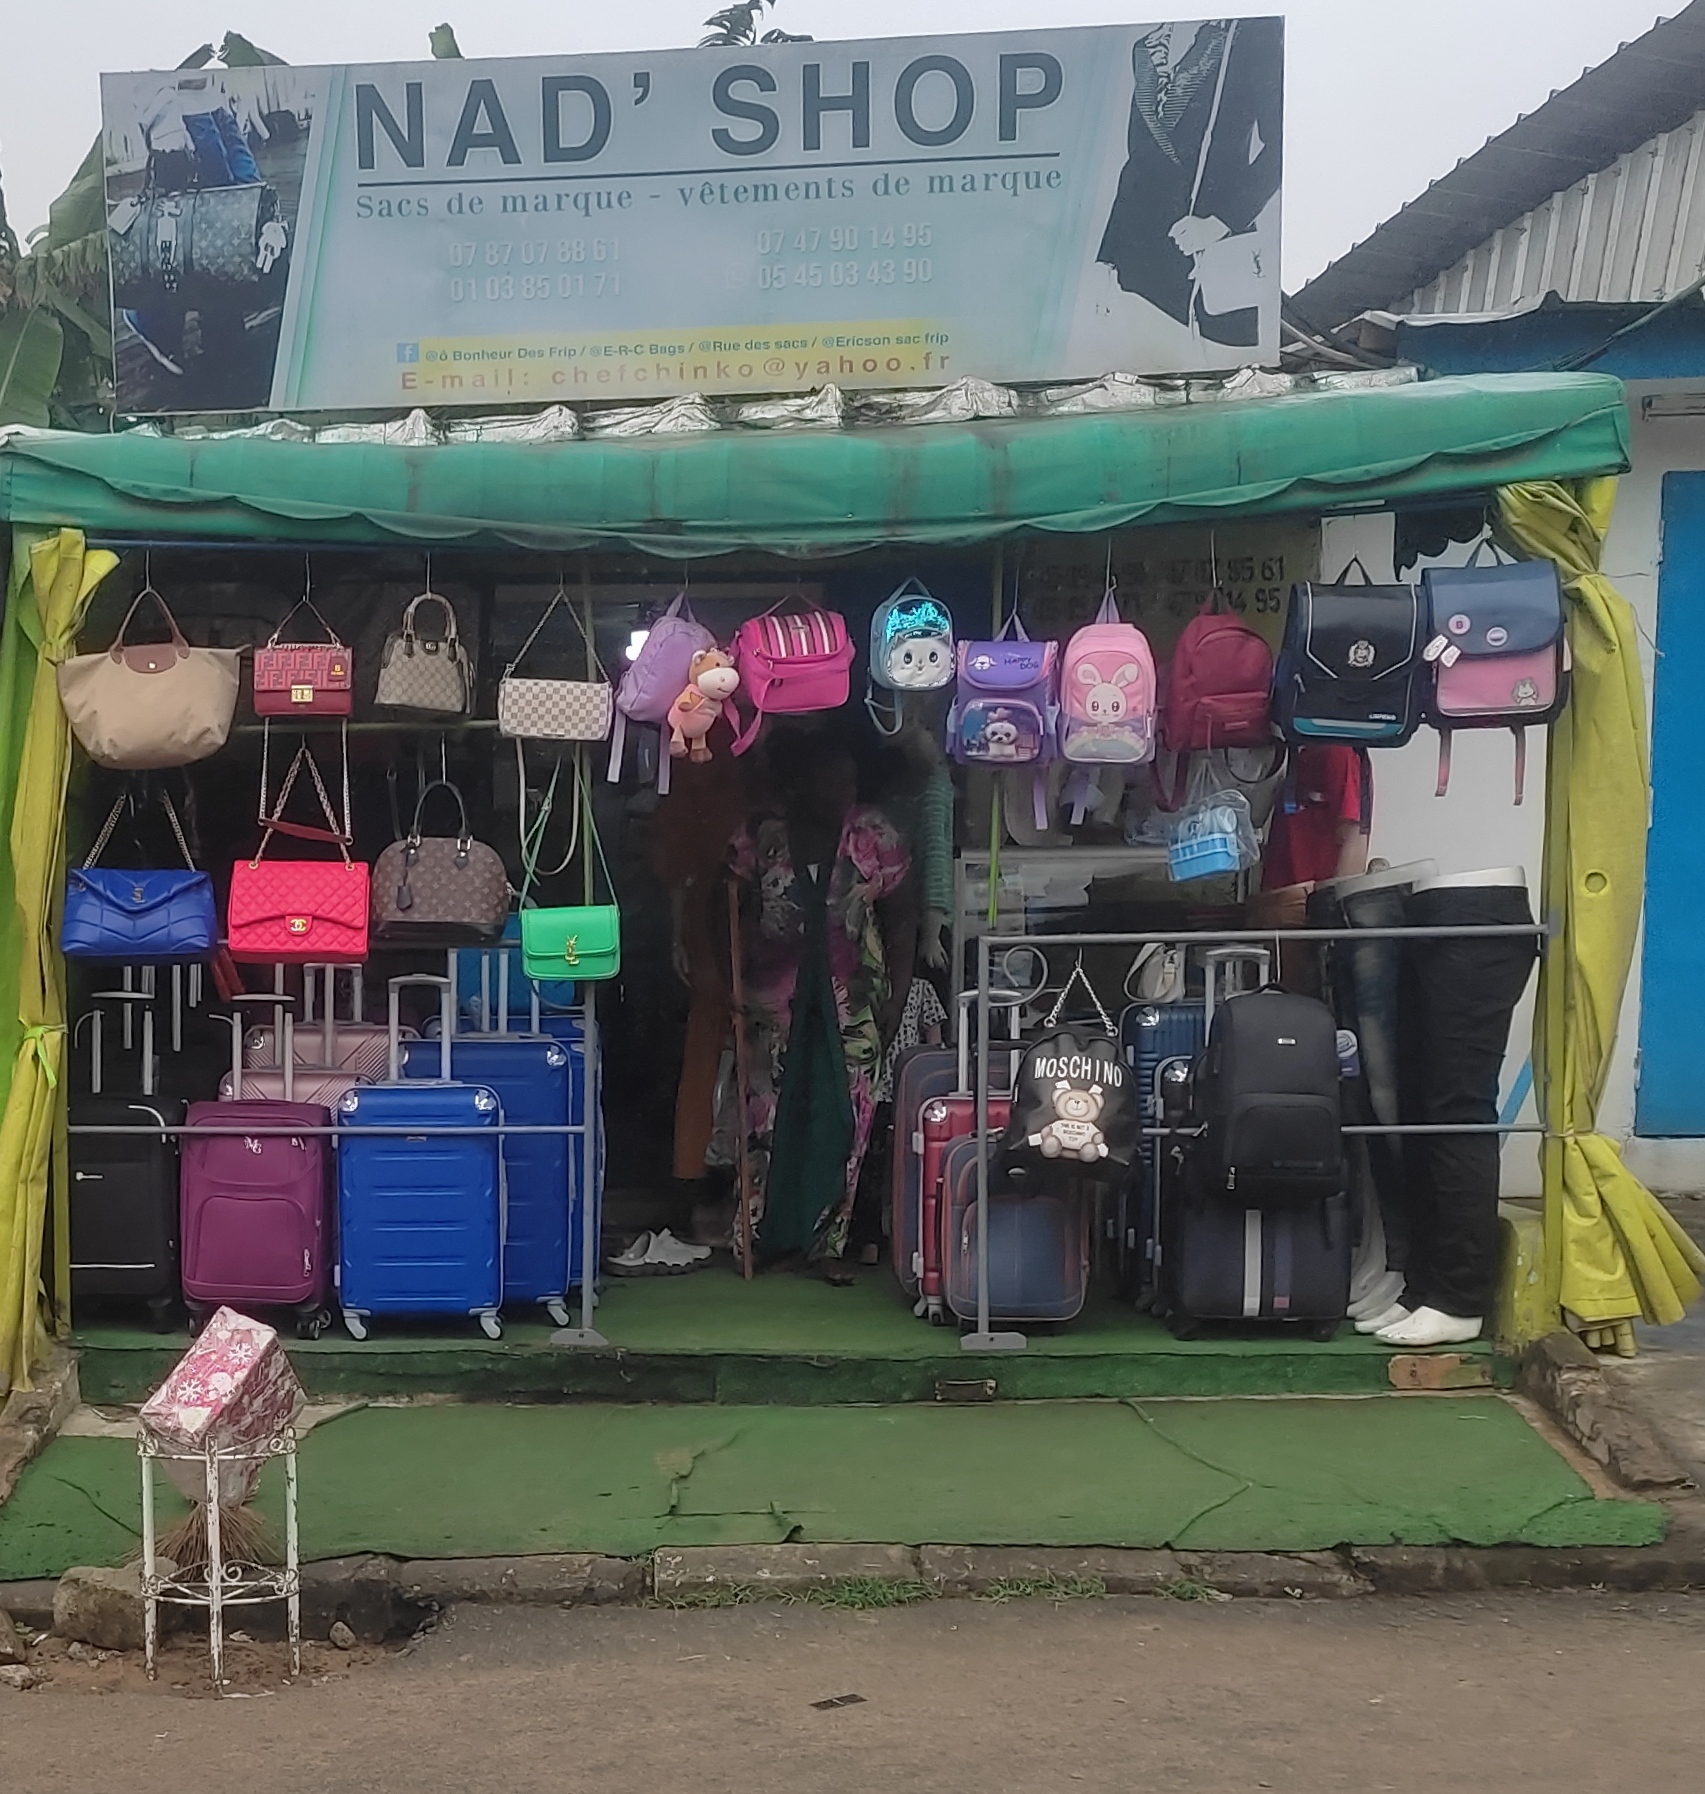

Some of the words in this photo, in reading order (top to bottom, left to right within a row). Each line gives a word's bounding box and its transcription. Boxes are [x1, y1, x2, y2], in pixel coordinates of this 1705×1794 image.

[710, 52, 1064, 156] SHOP
[356, 194, 430, 219] Sacs
[445, 192, 484, 215] de
[501, 188, 633, 217] marque
[677, 175, 855, 207] vêtements
[871, 172, 911, 197] de
[927, 168, 1063, 197] marque
[451, 242, 478, 267] 07
[485, 241, 513, 266] 87
[521, 239, 549, 264] 07
[557, 238, 586, 263] 88
[593, 237, 620, 262] 61
[757, 229, 786, 255] 07
[793, 226, 823, 253] 47
[829, 224, 859, 251] 90
[868, 222, 896, 249] 14
[902, 221, 933, 248] 95
[451, 276, 478, 302] 01
[485, 275, 514, 300] 03
[522, 274, 550, 299] 85
[557, 273, 584, 298] 01
[593, 272, 620, 297] 71
[758, 263, 787, 289] 05
[793, 262, 823, 287] 45
[829, 260, 859, 286] 03
[867, 258, 896, 285] 43
[903, 257, 933, 283] 90
[453, 349, 513, 361] Bonheur
[517, 347, 545, 359] Des
[549, 346, 577, 359] Frip
[590, 343, 644, 357] @E-R-C
[649, 343, 685, 356] Bags
[699, 340, 741, 352] @Rue
[744, 339, 771, 351] des
[774, 337, 808, 349] sacs
[822, 335, 891, 348] @Ericson
[895, 336, 921, 345] sac
[924, 331, 949, 346] frip
[551, 351, 951, 385] chefchinko@yahoo.fr
[1261, 554, 1285, 581] 61
[1254, 586, 1281, 614] 95
[1034, 1055, 1123, 1087] MOSCHINO
